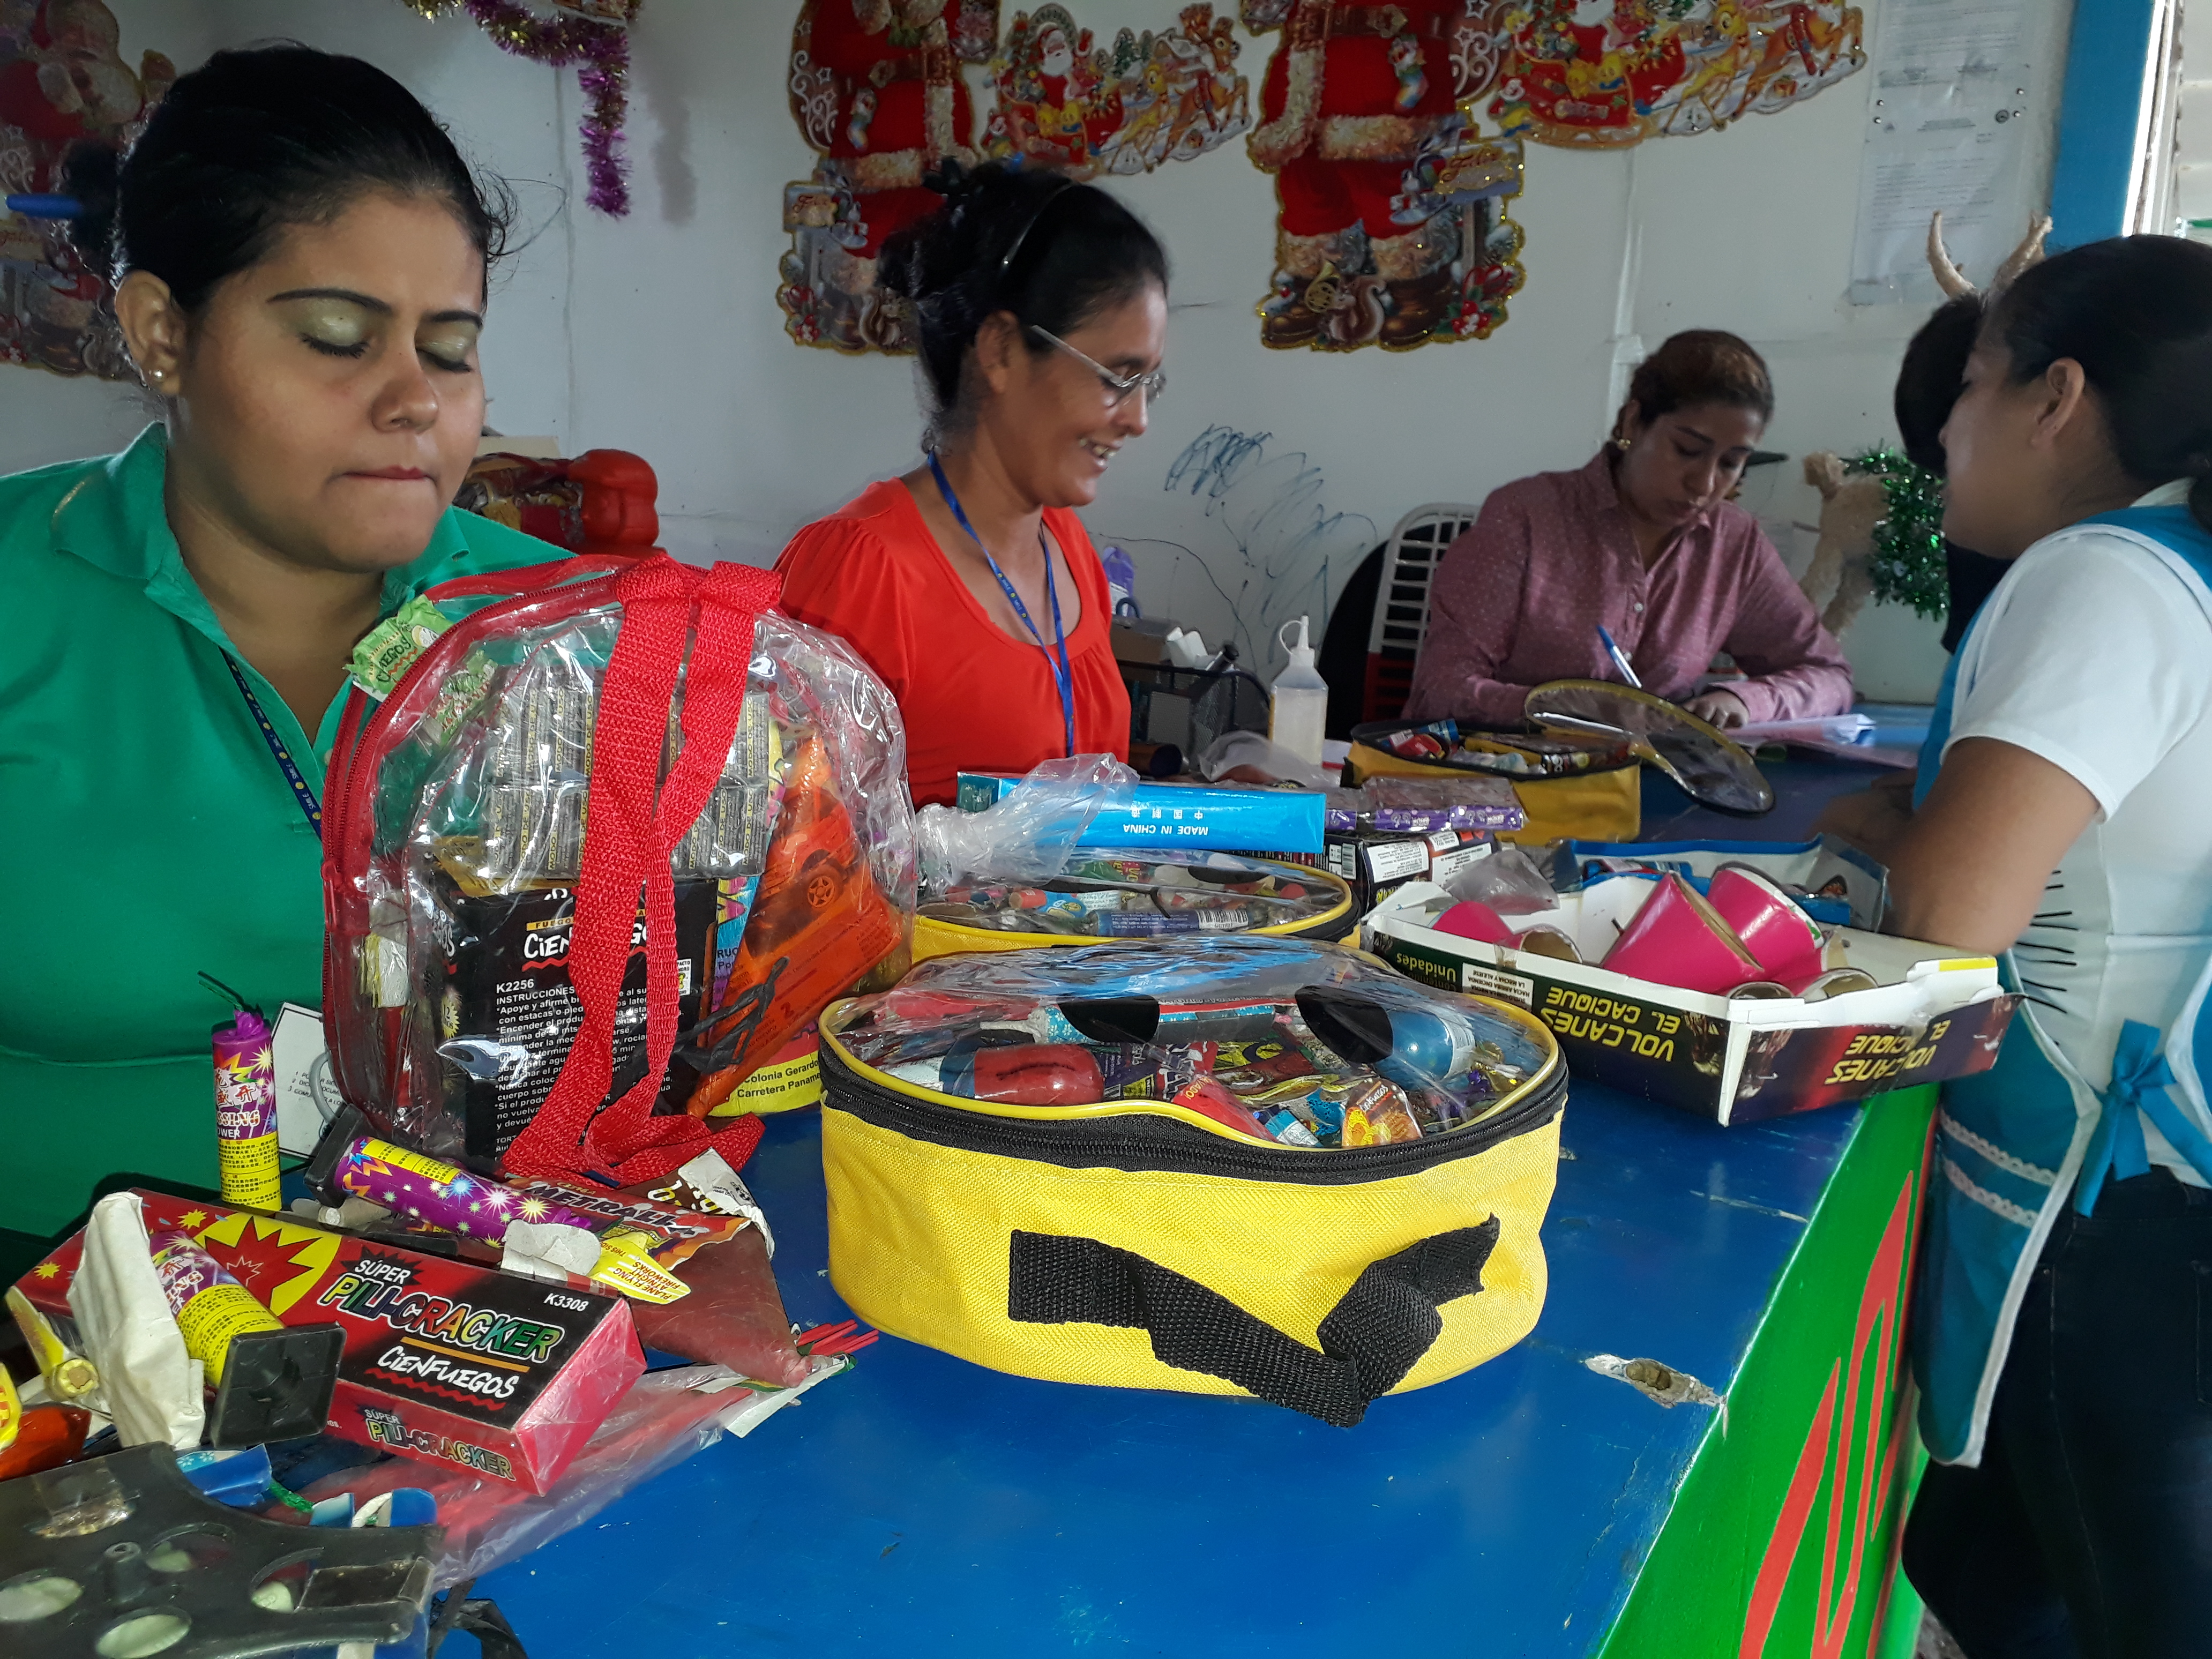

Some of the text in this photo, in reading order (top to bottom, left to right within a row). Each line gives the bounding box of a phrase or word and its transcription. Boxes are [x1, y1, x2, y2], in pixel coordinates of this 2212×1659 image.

[1123, 824, 1208, 835] MADE IN CHINA
[1396, 952, 1456, 983] Unidades
[496, 978, 535, 994] K2256
[496, 987, 575, 1005] INSTRUCCIONES
[499, 1017, 517, 1026] con
[519, 1011, 554, 1023] estacas
[564, 1005, 584, 1017] pied
[1545, 986, 1682, 1035] EL CACIQUE
[557, 1015, 584, 1028] produ
[1929, 1019, 1952, 1042] EL
[1541, 1007, 1675, 1063] VOLCANES
[744, 1059, 819, 1084] Colonia Gerardo
[497, 1086, 552, 1102] cuerpo sobr
[737, 1084, 786, 1098] Carretera
[520, 1096, 546, 1108] produ
[497, 1111, 508, 1120] no
[504, 1116, 532, 1126] devué
[354, 1259, 412, 1284] SÚPER
[632, 1260, 681, 1289] FIREWORKS
[544, 1292, 589, 1312] K3308
